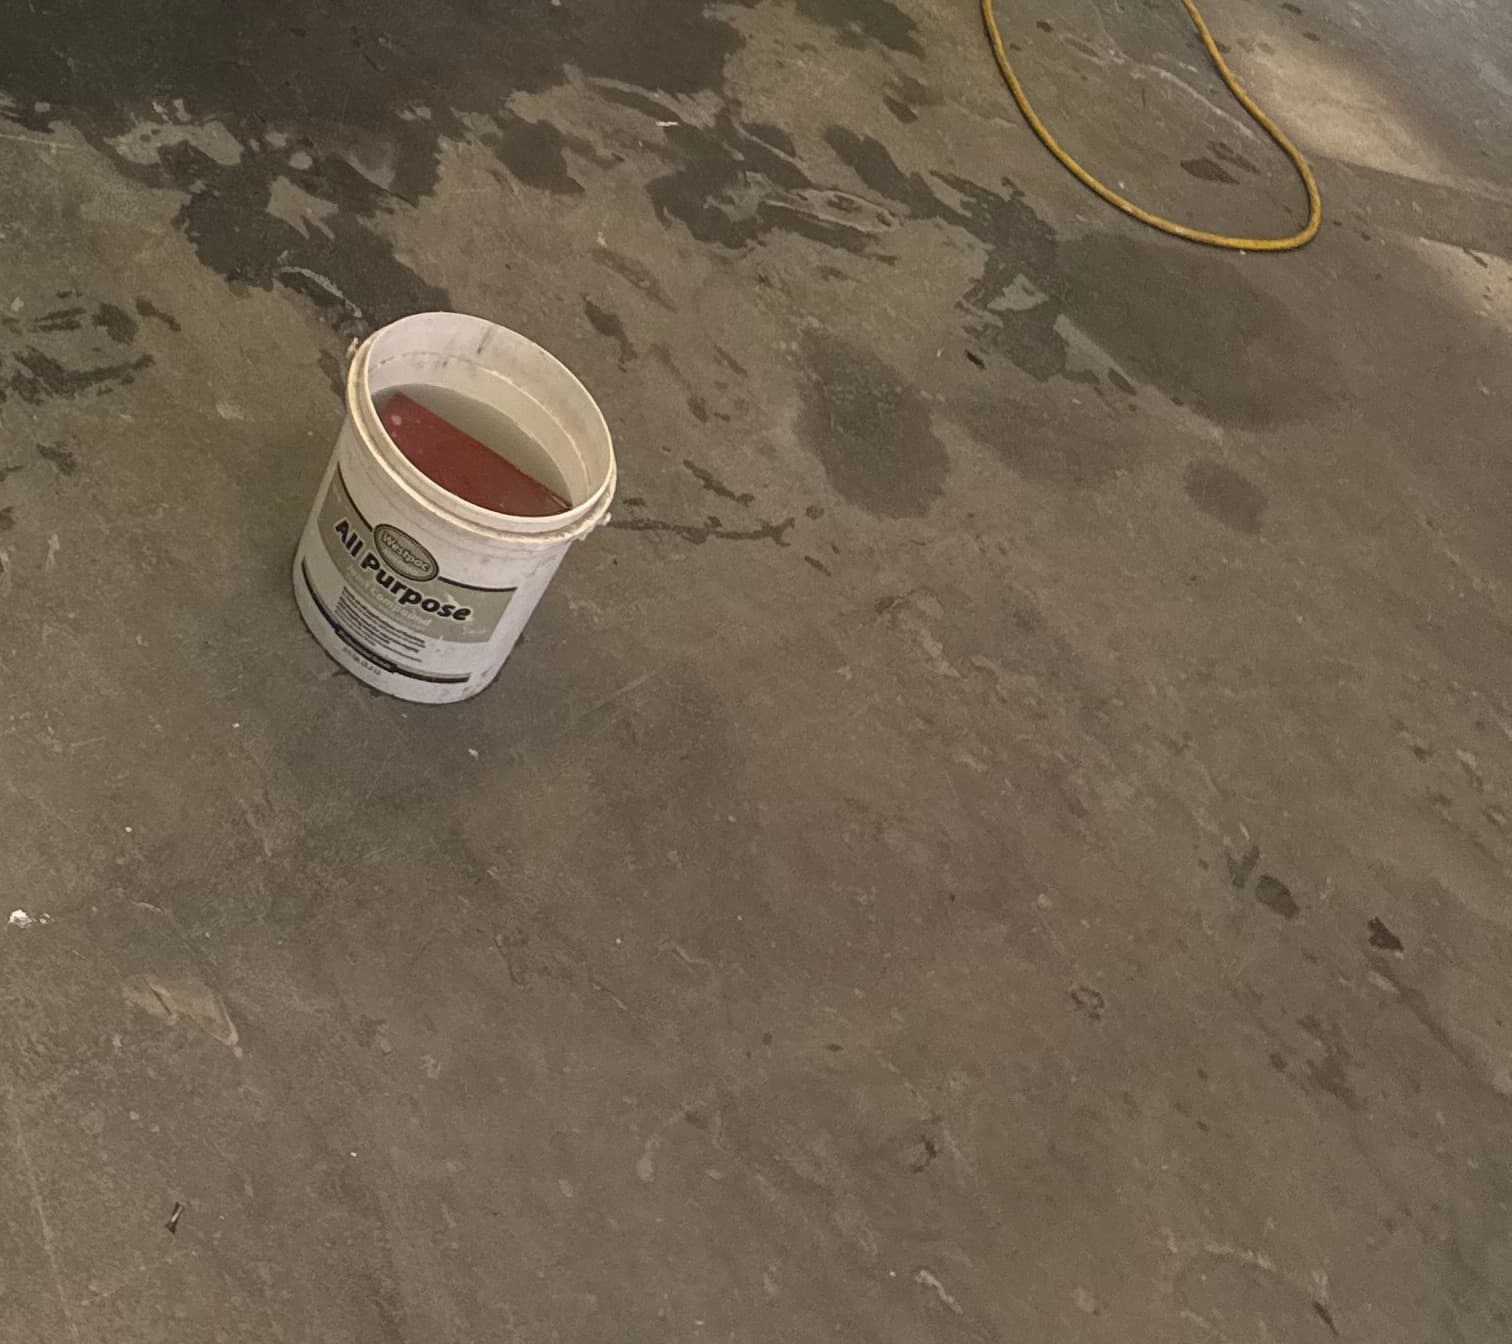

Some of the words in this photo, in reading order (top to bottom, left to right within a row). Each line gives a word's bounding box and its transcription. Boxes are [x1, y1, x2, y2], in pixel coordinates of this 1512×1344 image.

[335, 519, 364, 558] All
[360, 552, 472, 622] Purpose
[382, 530, 431, 573] Westpac
